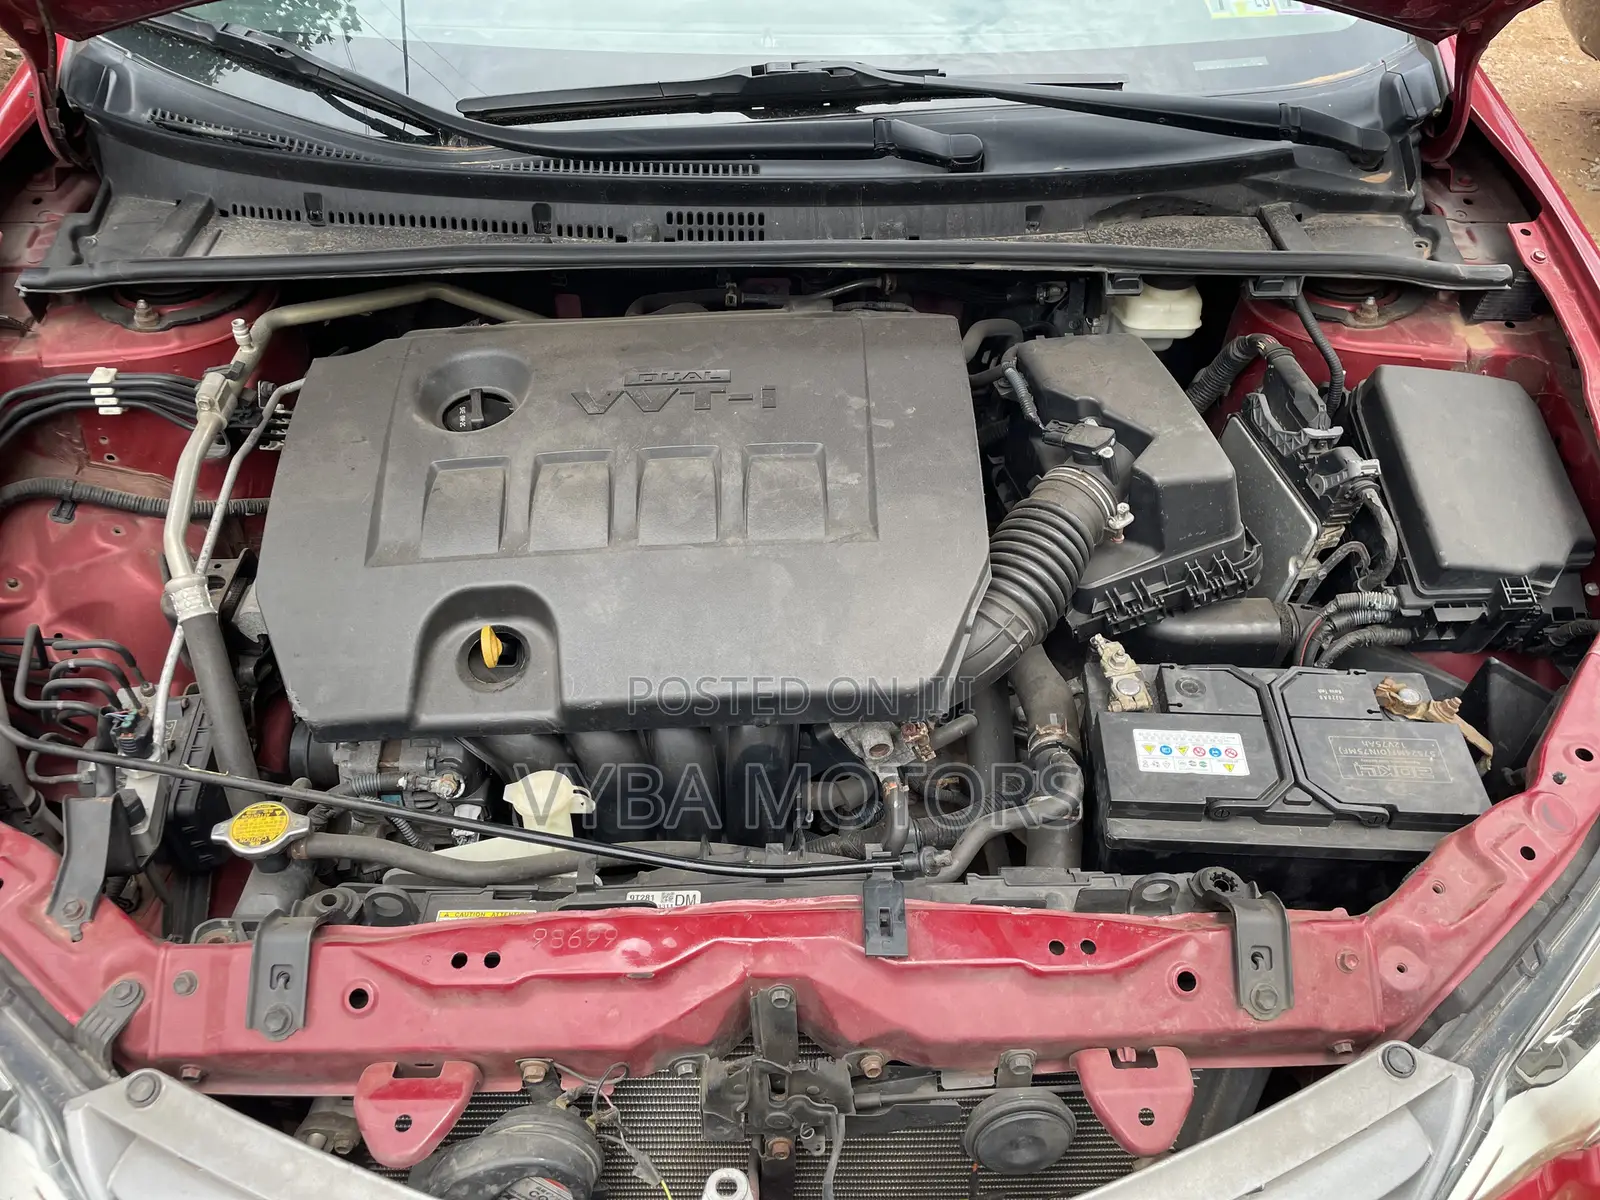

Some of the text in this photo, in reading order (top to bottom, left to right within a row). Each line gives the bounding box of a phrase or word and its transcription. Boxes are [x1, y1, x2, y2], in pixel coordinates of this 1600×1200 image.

[638, 371, 722, 382] DUAL
[675, 894, 697, 906] DM
[531, 927, 619, 950] 98699
